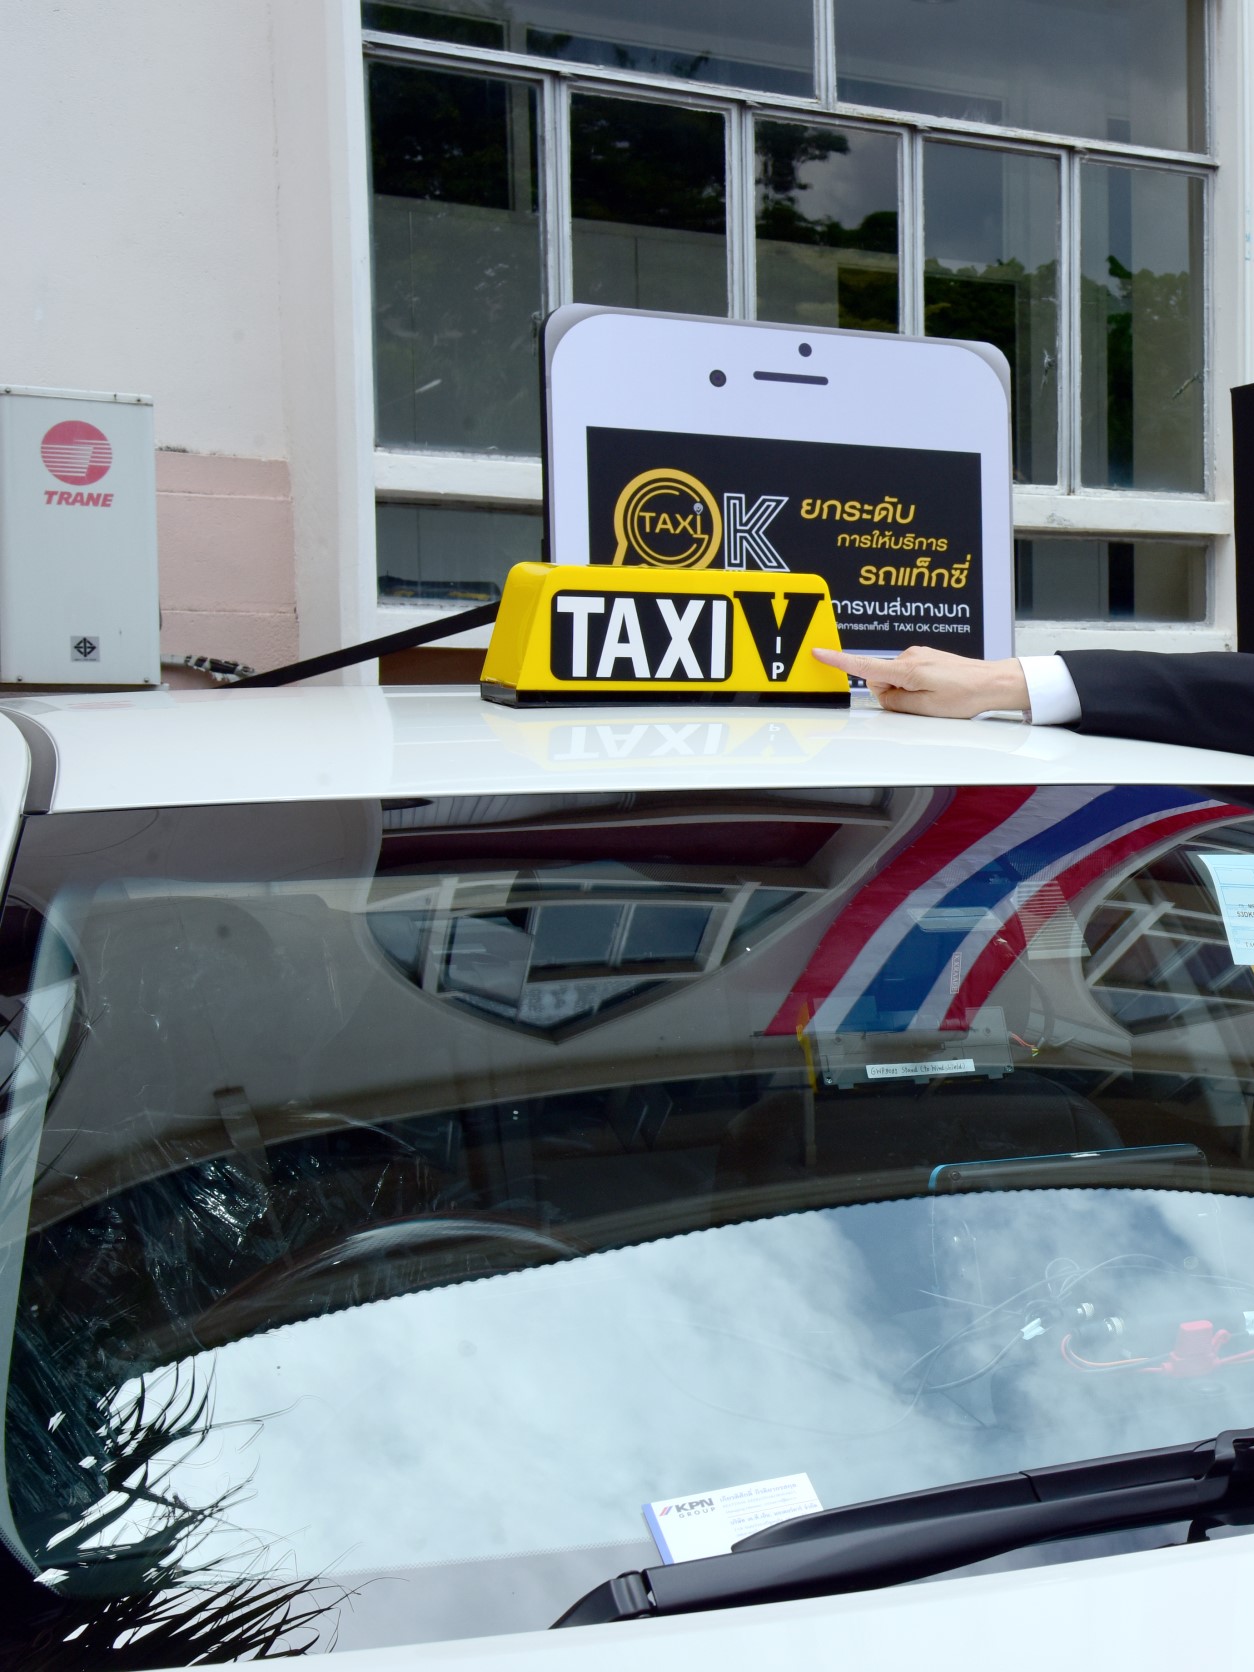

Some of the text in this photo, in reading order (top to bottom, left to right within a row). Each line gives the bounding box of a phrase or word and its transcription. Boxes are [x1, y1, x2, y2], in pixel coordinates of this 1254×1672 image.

[44, 490, 114, 507] TRANE
[800, 496, 916, 524] ยกระดับ
[837, 530, 948, 551] การให้บริการ
[859, 554, 971, 588] รถแท็กซี่
[831, 597, 970, 618] การขนส่งทางบก
[556, 595, 728, 679] TAXI
[893, 622, 914, 632] TAXI
[916, 623, 930, 633] OK
[932, 623, 971, 633] CENTER
[675, 1497, 714, 1513] KPN
[678, 1507, 716, 1519] GROUP
